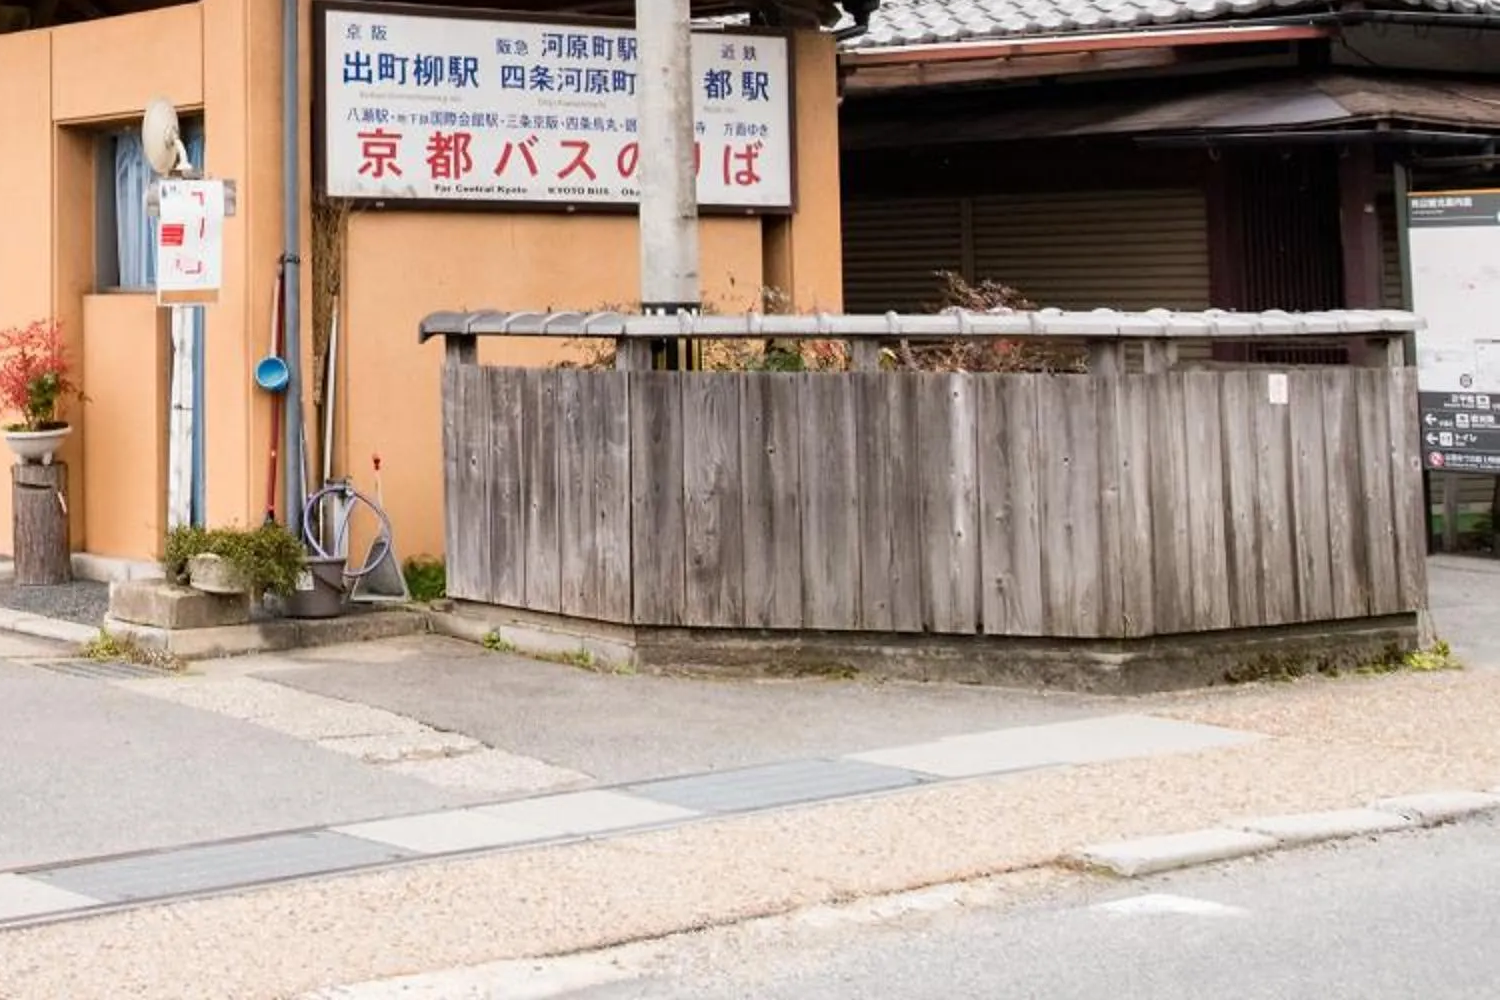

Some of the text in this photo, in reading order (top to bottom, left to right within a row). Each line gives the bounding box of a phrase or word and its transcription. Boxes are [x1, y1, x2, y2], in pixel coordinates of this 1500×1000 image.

[345, 23, 388, 41] 京阪
[496, 32, 638, 62] 阪急 河原町駅
[720, 43, 758, 61] 近鉄
[343, 50, 480, 89] 出町柳駅
[500, 64, 638, 96] 四条河原町
